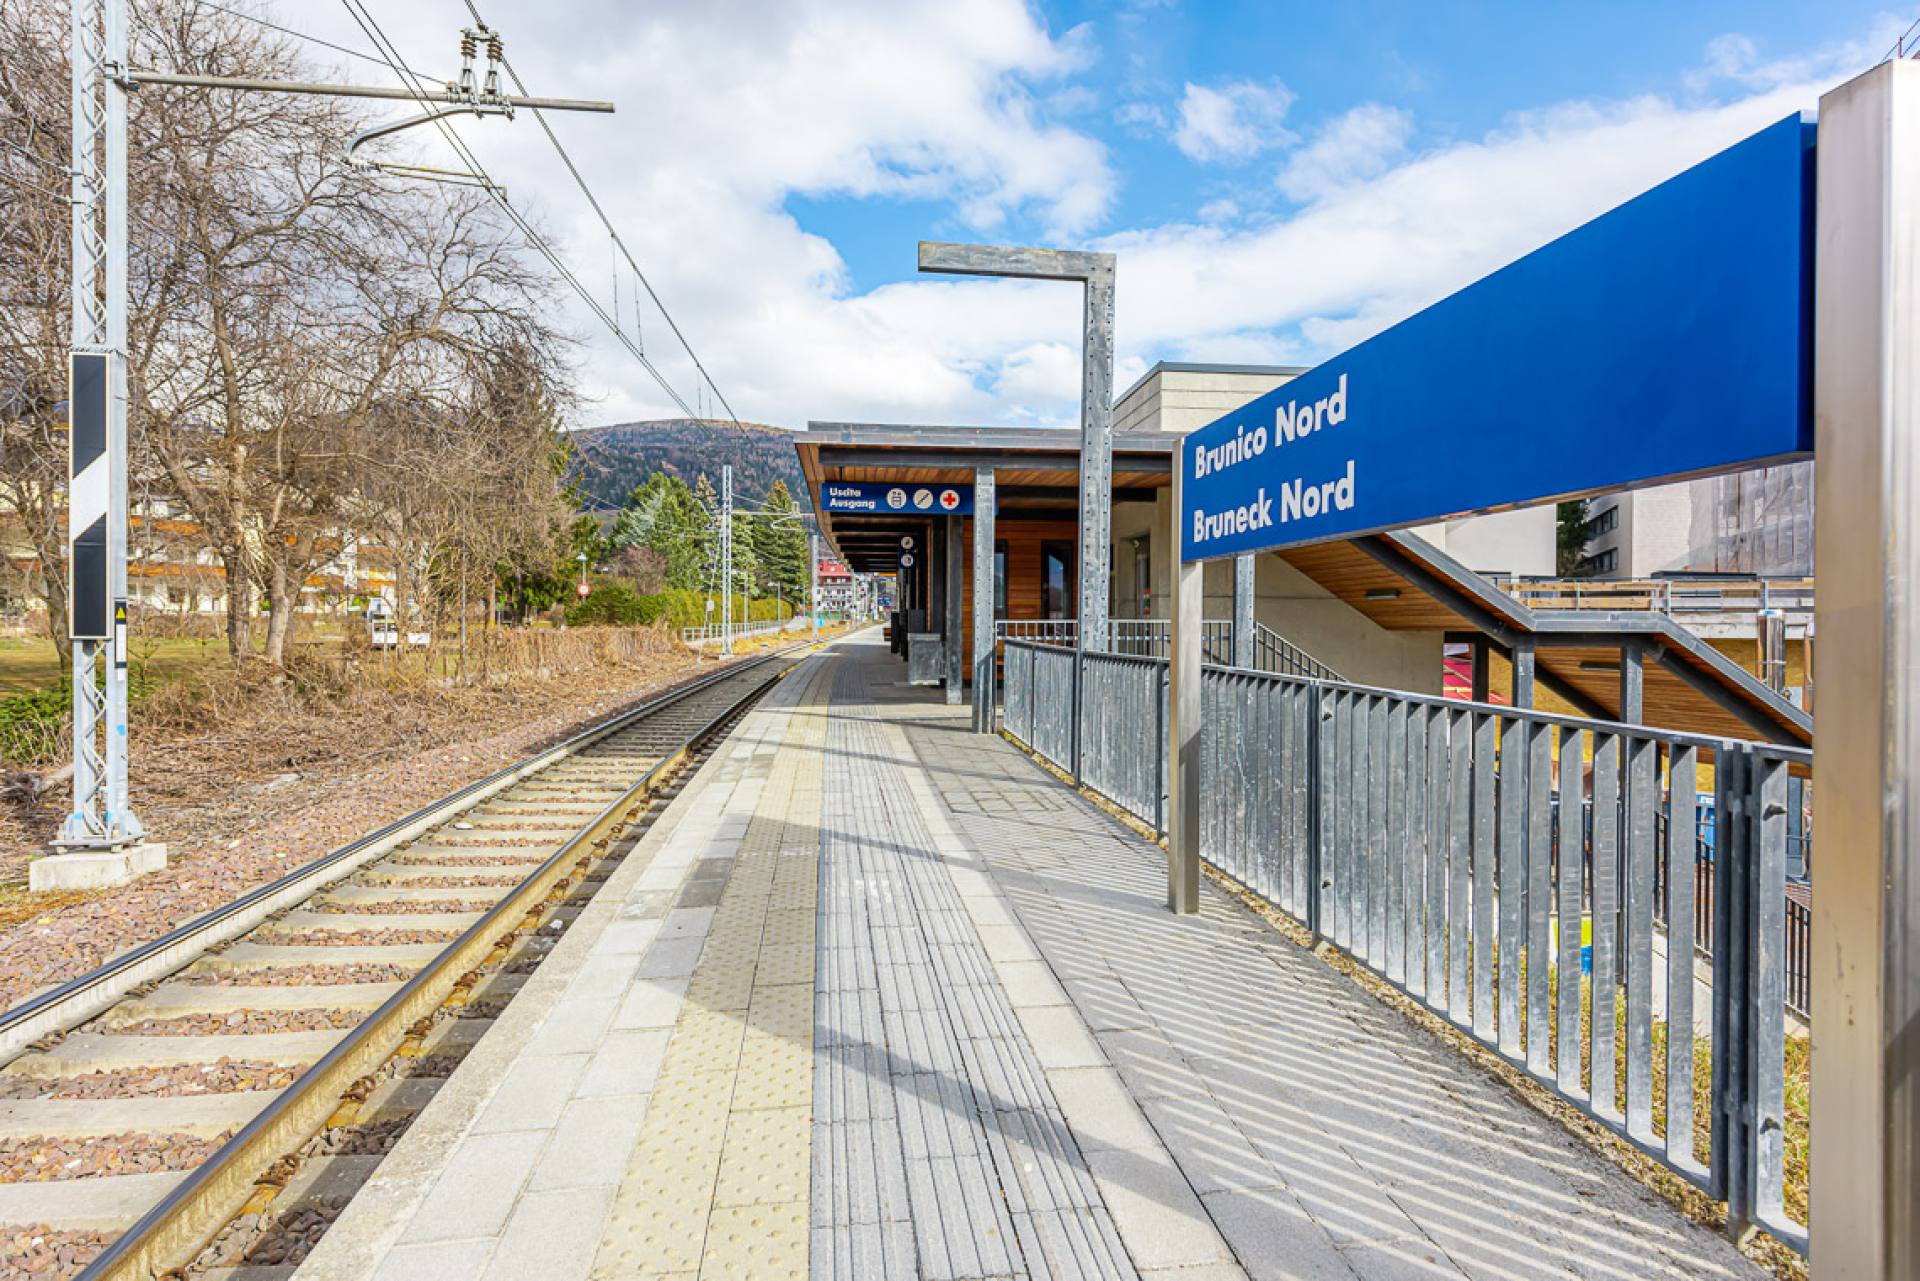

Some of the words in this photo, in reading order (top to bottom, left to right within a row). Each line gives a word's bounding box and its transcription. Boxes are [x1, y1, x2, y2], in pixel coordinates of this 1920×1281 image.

[1195, 425, 1268, 480] Brunico
[1274, 373, 1348, 447] Nord
[829, 487, 862, 497] Uscita
[830, 498, 876, 510] Ausgang
[1193, 487, 1273, 543] Bruneck
[1280, 460, 1355, 523] Nord
